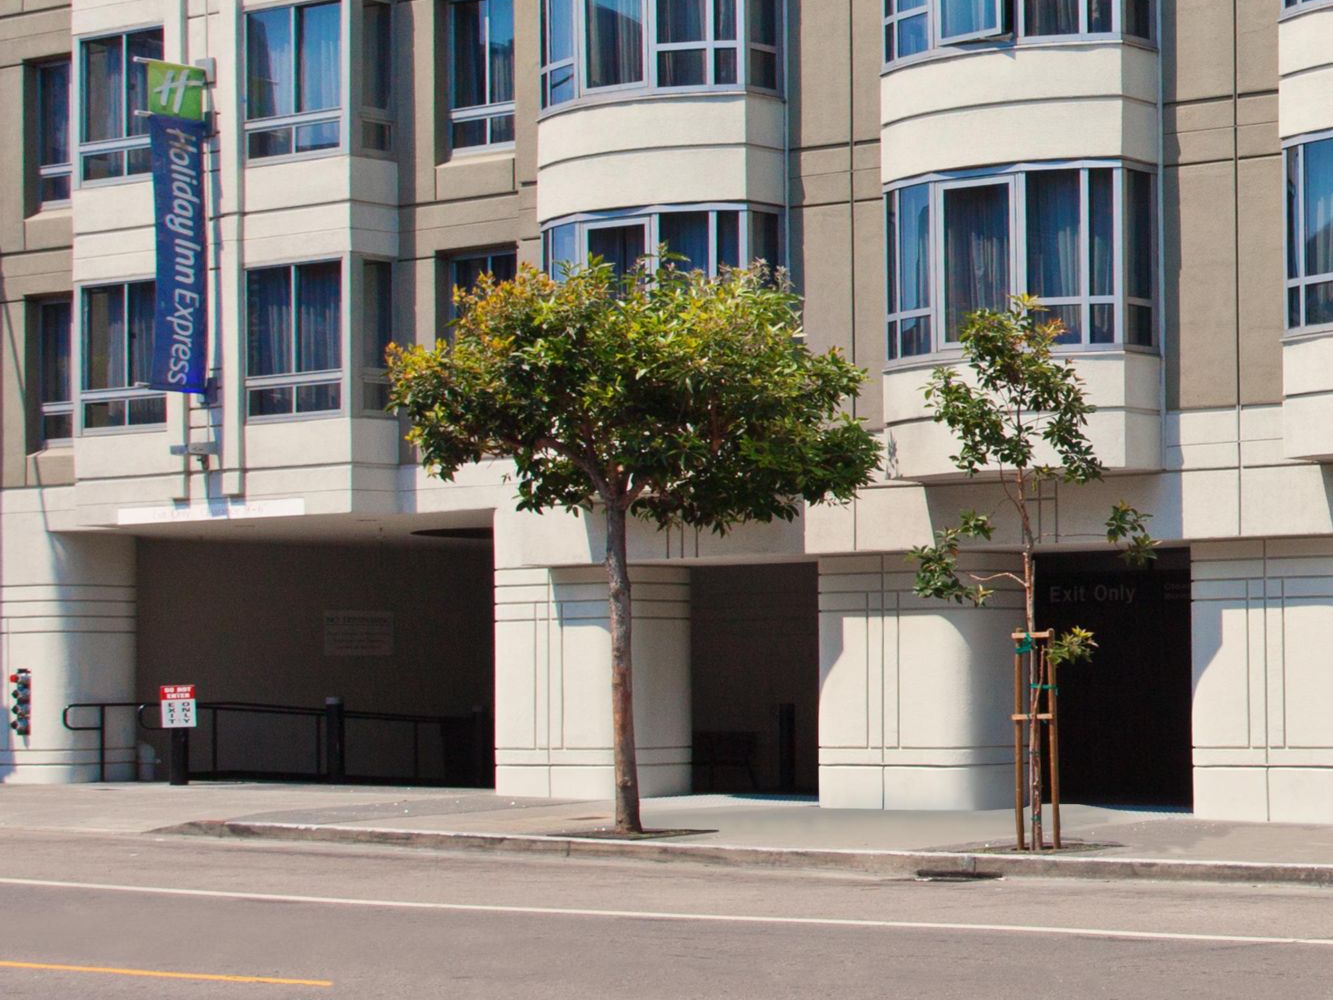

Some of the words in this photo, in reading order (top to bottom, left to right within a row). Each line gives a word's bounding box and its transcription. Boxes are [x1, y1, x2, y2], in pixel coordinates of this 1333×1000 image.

[165, 127, 200, 237] Holiday
[174, 238, 201, 284] Inn
[166, 288, 199, 385] Express
[1050, 586, 1085, 602] Exit
[1093, 584, 1136, 604] Only
